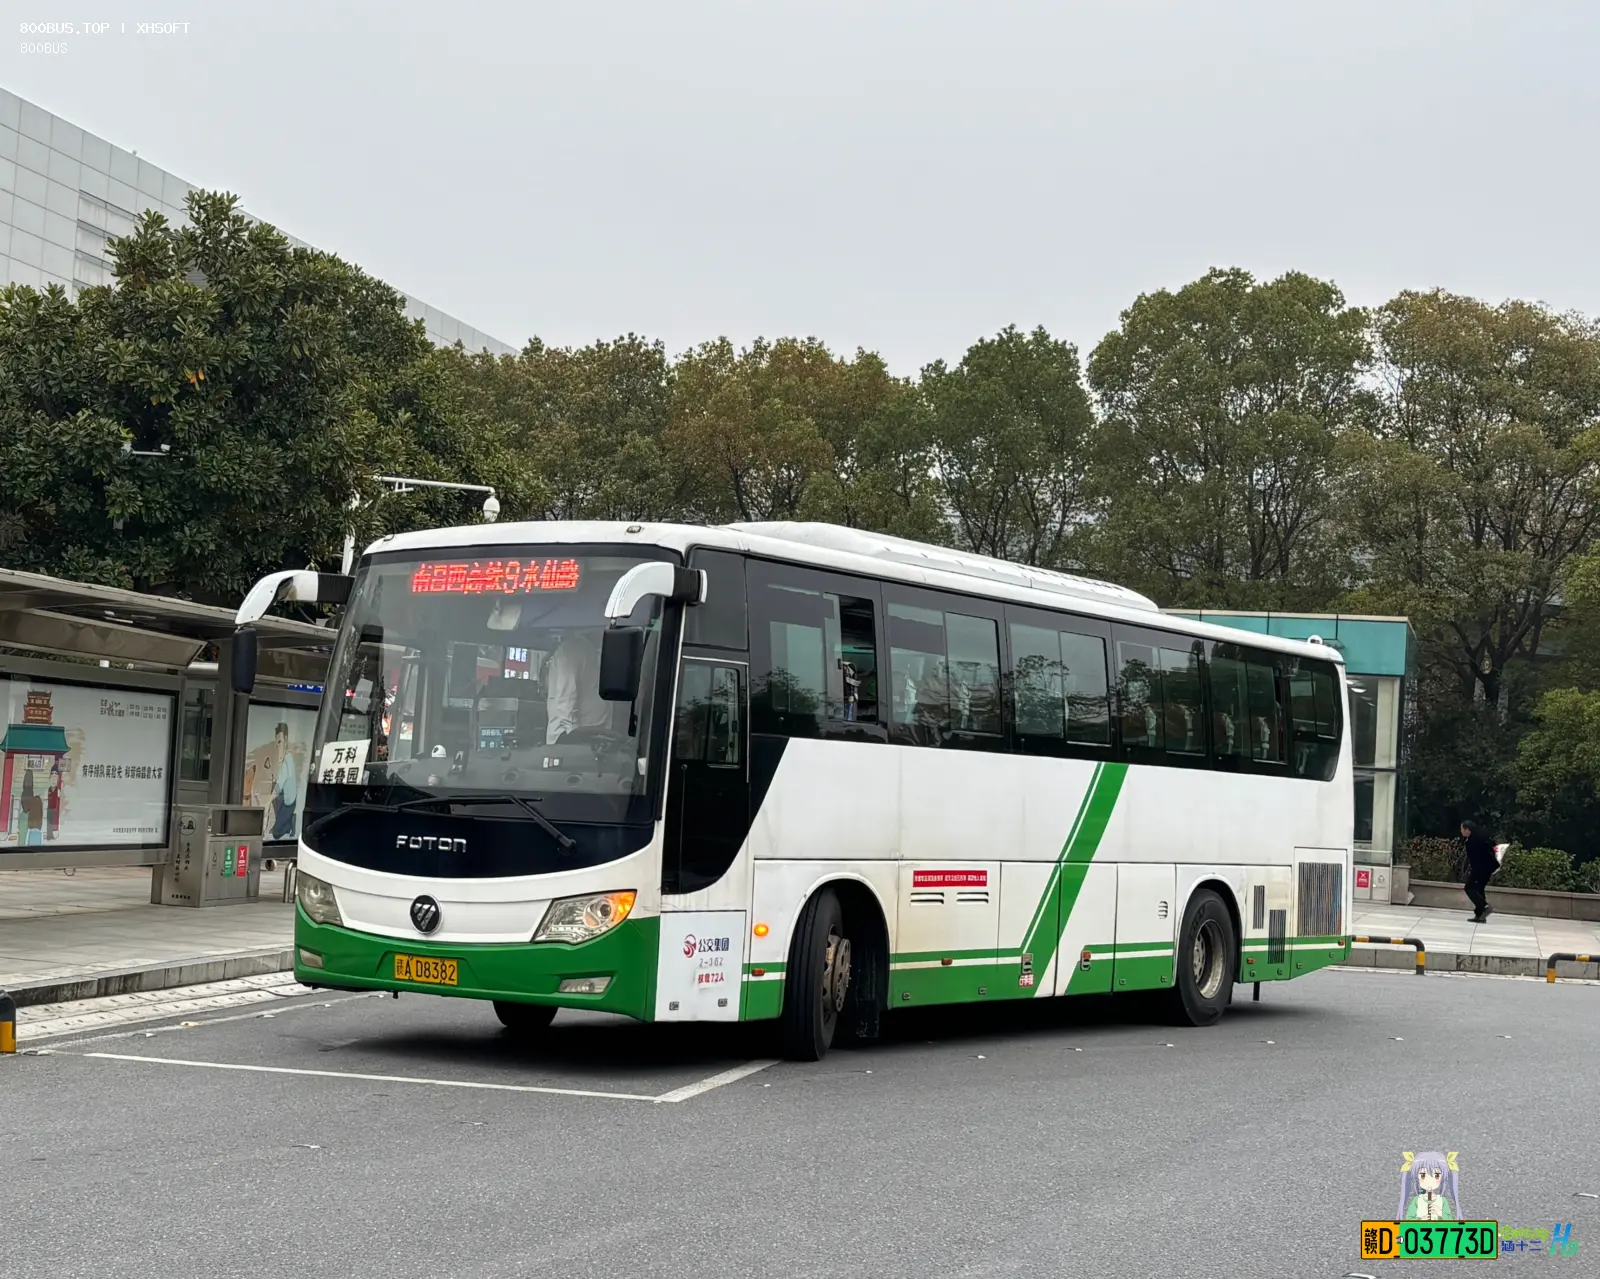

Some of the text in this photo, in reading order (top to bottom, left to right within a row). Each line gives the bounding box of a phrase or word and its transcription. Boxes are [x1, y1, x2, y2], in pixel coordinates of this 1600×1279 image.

[332, 746, 357, 764] 万科
[395, 834, 467, 853] FOTON
[698, 937, 730, 952] 公交集团
